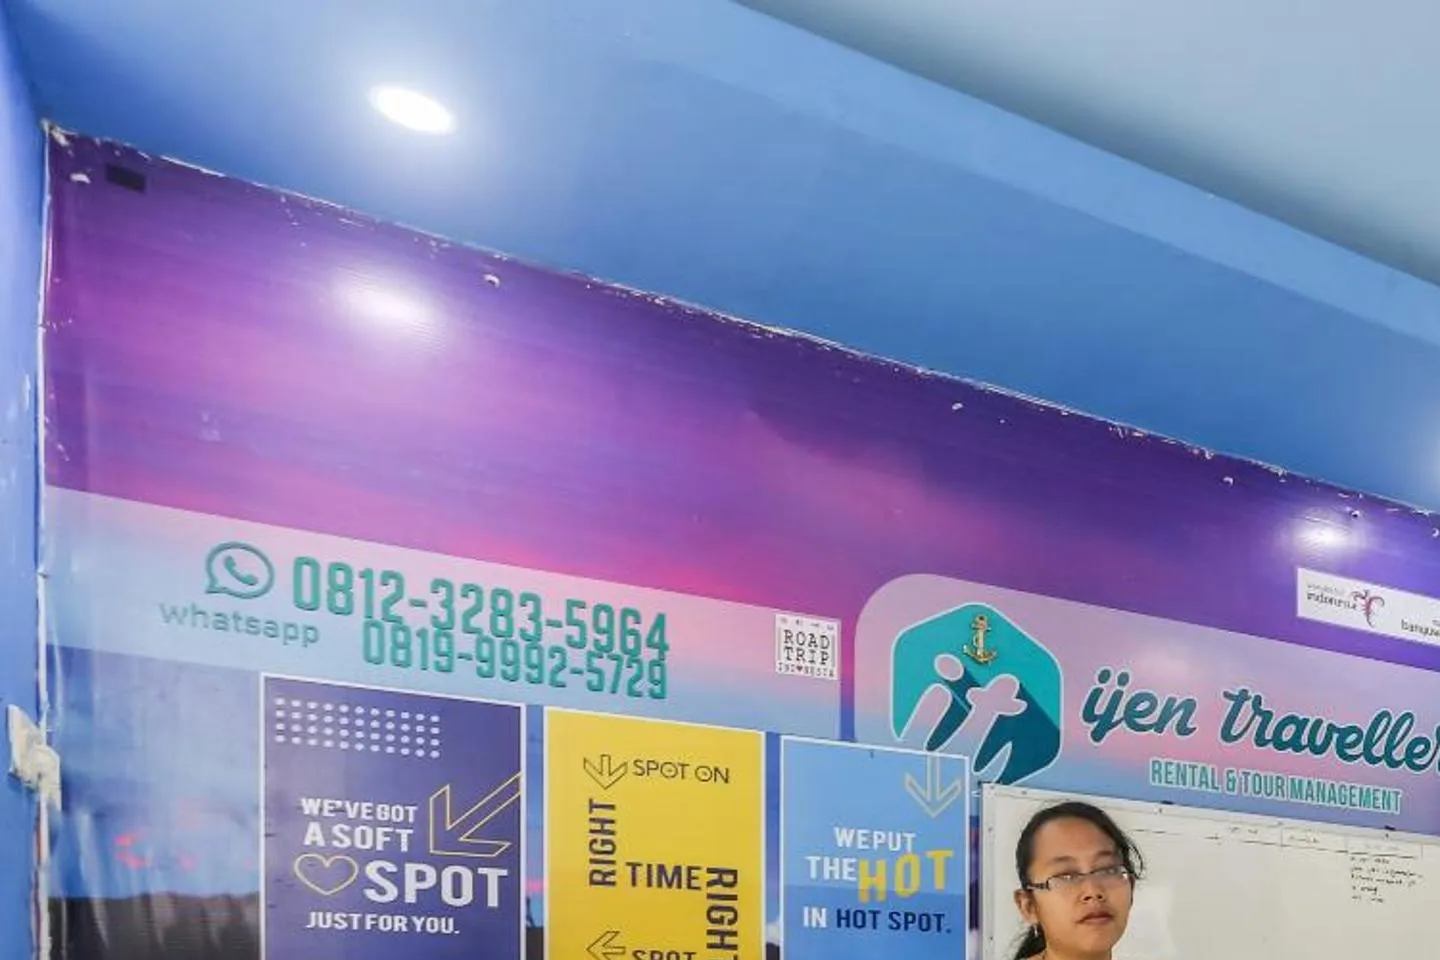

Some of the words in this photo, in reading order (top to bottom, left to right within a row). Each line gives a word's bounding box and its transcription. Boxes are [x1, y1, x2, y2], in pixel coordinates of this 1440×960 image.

[292, 556, 670, 661] 0812-3283-5964
[158, 602, 320, 648] whatsapp
[783, 629, 831, 650] ROAD
[361, 618, 668, 699] 0819-9992-5729
[783, 646, 830, 665] TRIP
[1081, 666, 1199, 745] ijen
[632, 758, 690, 780] SPOT
[694, 765, 730, 784] ON
[1150, 758, 1221, 791] RENTAL
[1225, 768, 1238, 793] &
[1240, 770, 1287, 801] TOUR
[1287, 775, 1402, 814] MANAGEMENT
[300, 798, 373, 821] WE'VE
[376, 804, 418, 823] GOT
[303, 822, 325, 847] A
[331, 824, 414, 852] SOFT
[588, 798, 618, 887] RIGHT
[833, 826, 870, 850] WE
[872, 830, 917, 853] PUT
[364, 859, 508, 908] SPOT
[625, 861, 702, 891] TIME
[804, 855, 858, 882] THE
[858, 849, 954, 904] HOT
[306, 911, 361, 931] JUST
[365, 913, 408, 932] FOR
[411, 916, 460, 935] YOU.
[803, 906, 828, 929] IN
[836, 908, 881, 931] HOT
[888, 911, 952, 934] SPOT.
